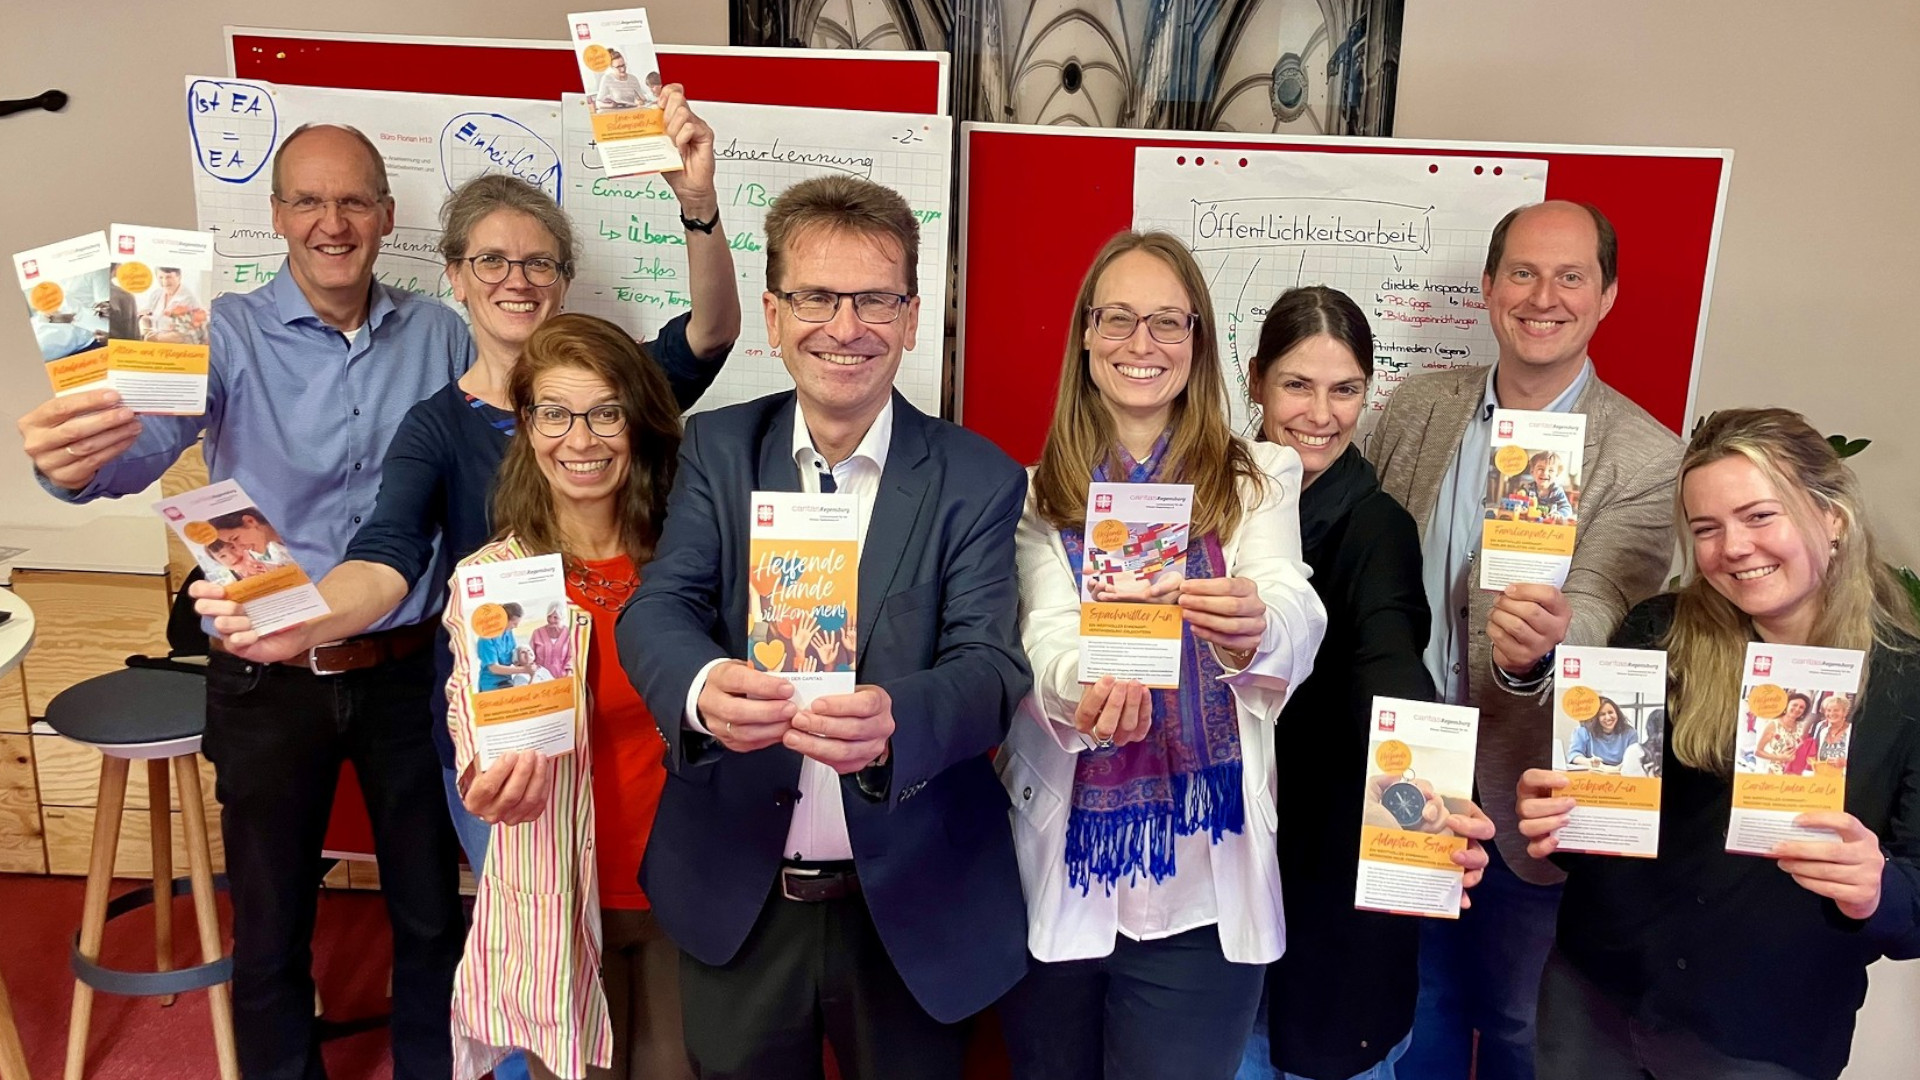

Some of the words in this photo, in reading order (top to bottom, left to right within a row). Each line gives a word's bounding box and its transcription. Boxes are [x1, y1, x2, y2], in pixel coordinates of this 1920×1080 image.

[230, 92, 263, 116] EA
[207, 150, 245, 168] EA
[1198, 204, 1418, 245] Öffentlichkeitsarbeit
[631, 255, 676, 281] Infos
[1373, 354, 1412, 373] Flyer
[754, 548, 845, 582] Helfende
[766, 575, 834, 606] Hände
